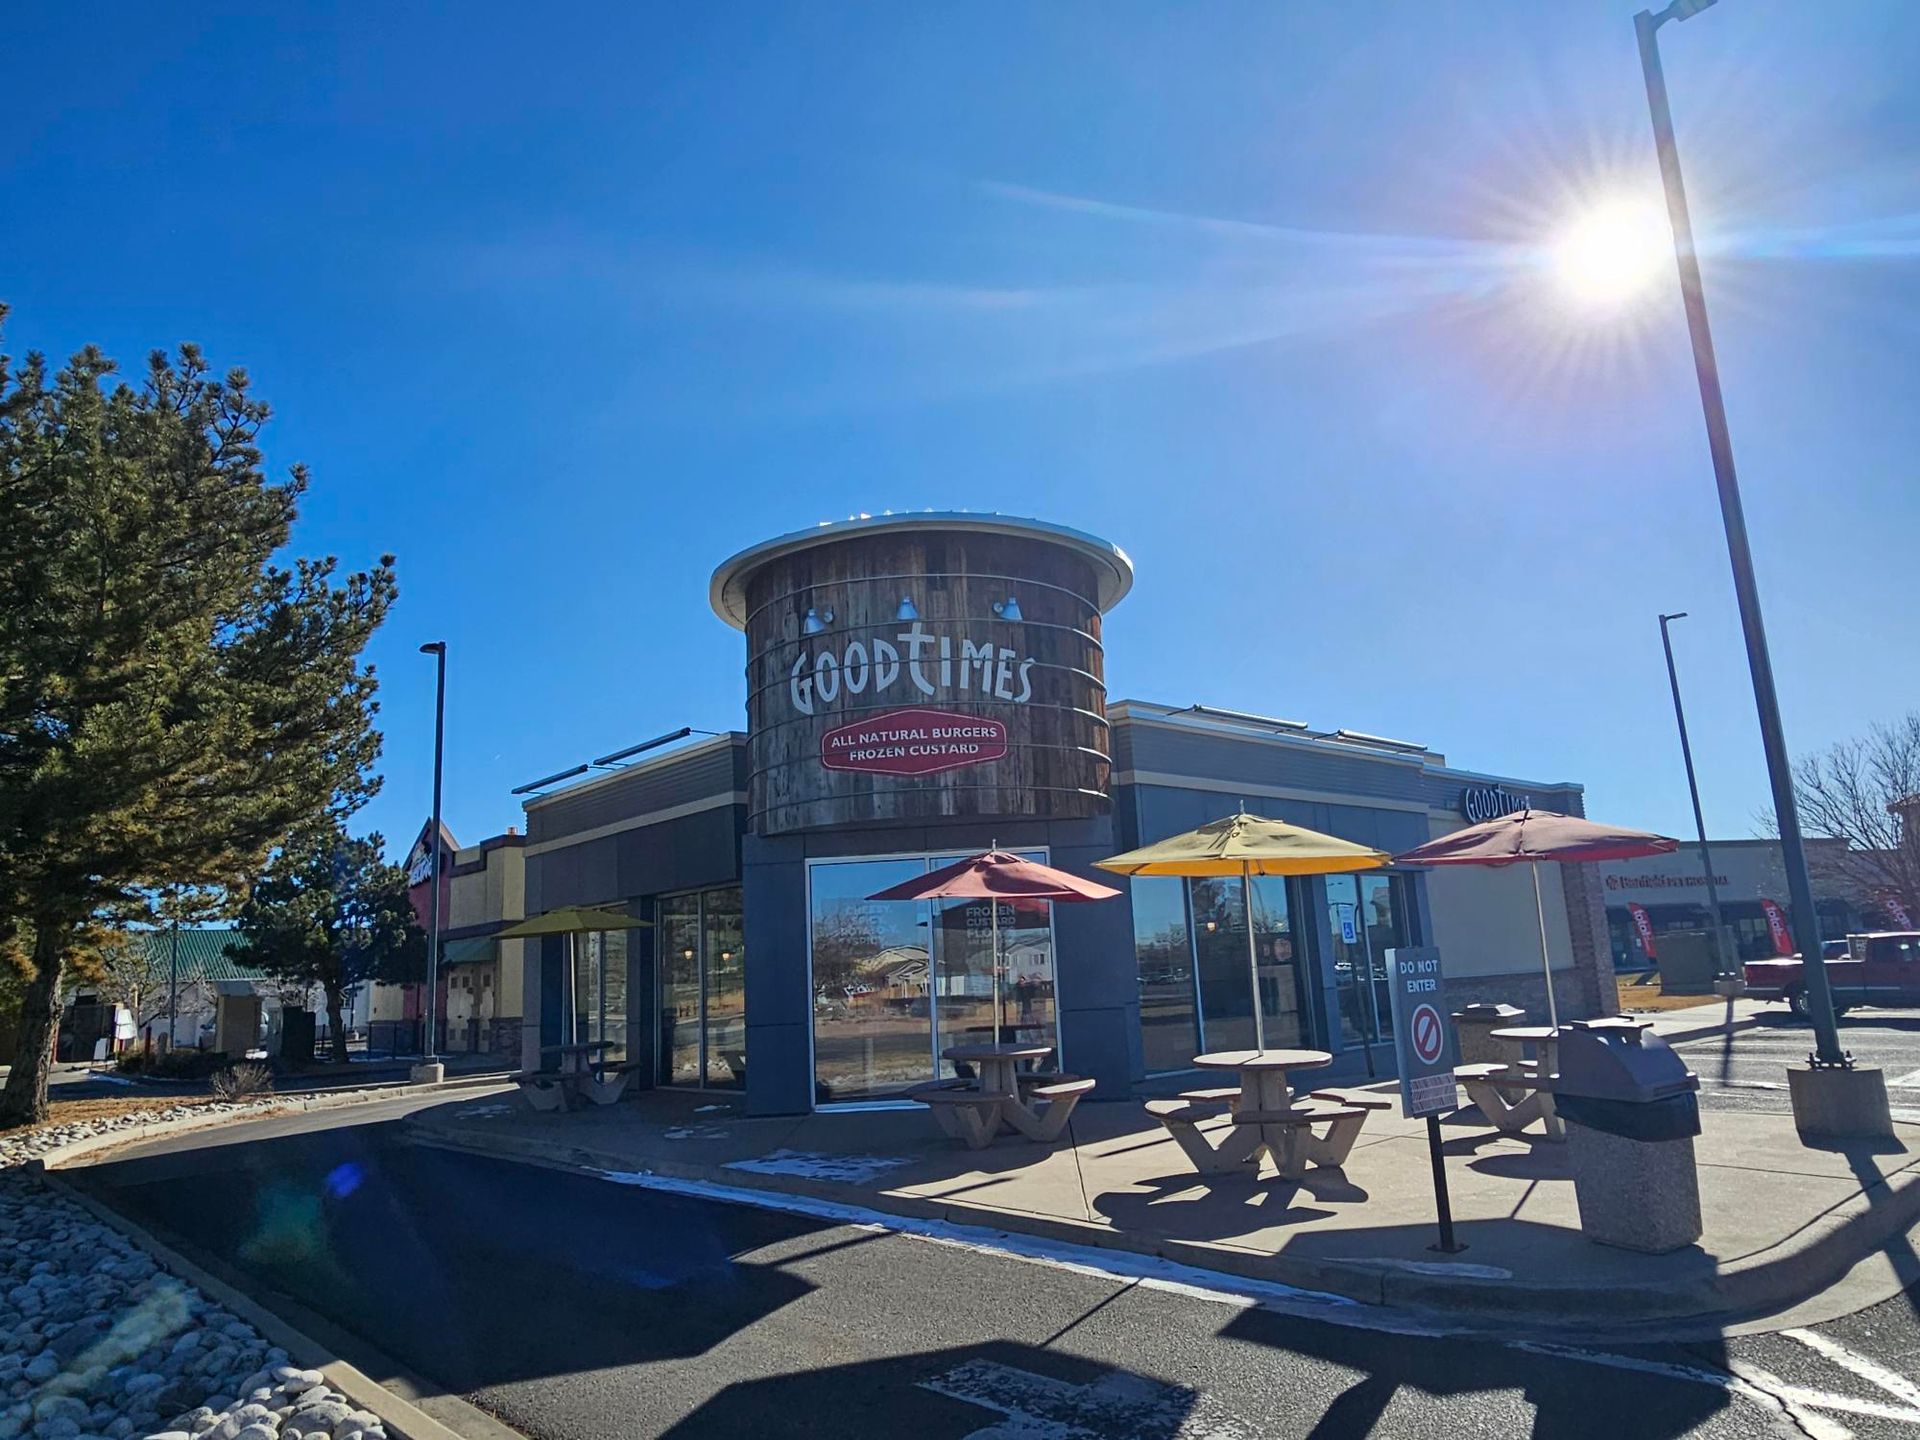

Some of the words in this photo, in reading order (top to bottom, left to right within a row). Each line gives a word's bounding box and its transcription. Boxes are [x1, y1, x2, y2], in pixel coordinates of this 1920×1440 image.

[831, 735, 855, 748] ALL
[859, 729, 928, 745] NATURAL
[932, 727, 998, 739] BURGERS
[849, 746, 905, 761] FROZEN
[909, 743, 979, 756] CUSTARD
[1400, 961, 1415, 974] DO
[1417, 960, 1438, 973] NOT
[1407, 978, 1437, 993] ENTER
